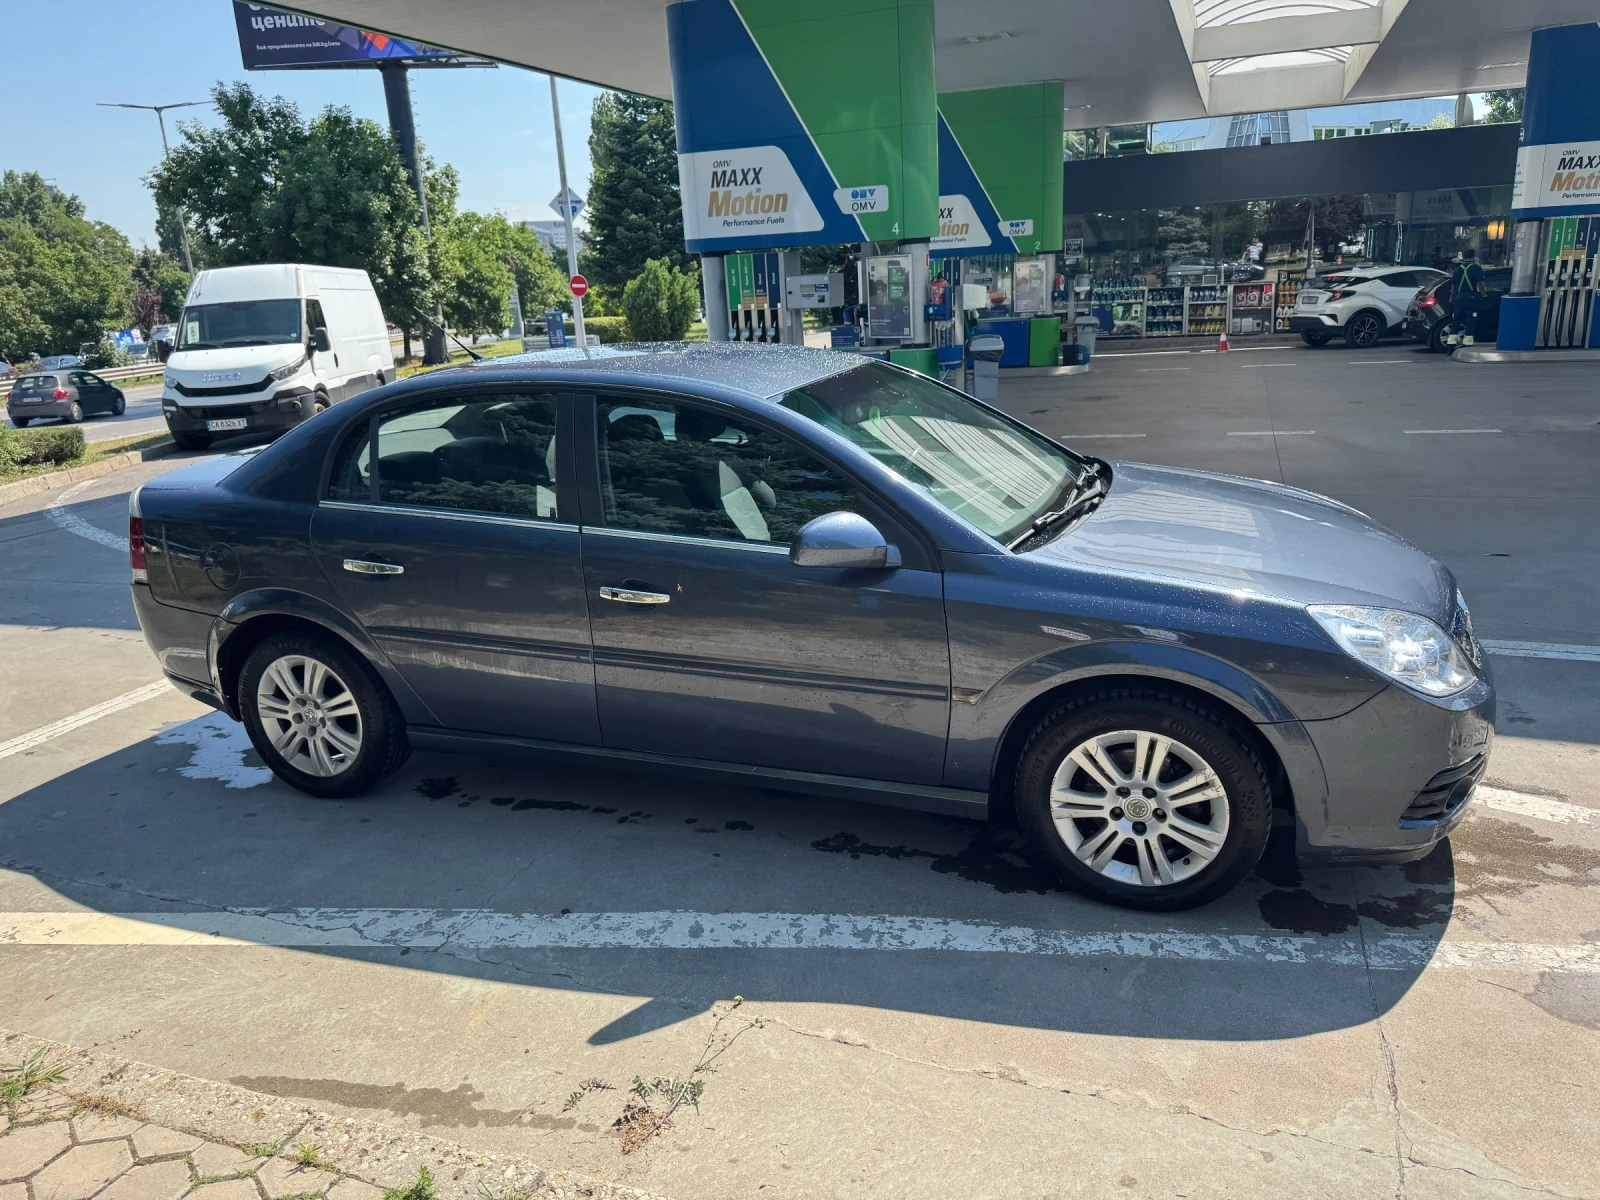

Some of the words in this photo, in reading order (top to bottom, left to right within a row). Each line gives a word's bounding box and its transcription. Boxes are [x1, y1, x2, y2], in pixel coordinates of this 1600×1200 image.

[712, 160, 732, 168] OMV
[710, 166, 763, 189] MAXX
[707, 187, 789, 218] Motion
[851, 201, 876, 211] OMV
[723, 218, 765, 228] Performance
[766, 216, 785, 225] Fuels
[891, 222, 900, 235] 4
[1034, 241, 1041, 250] 2
[203, 372, 241, 382] IVECO
[220, 420, 237, 428] 8326
[1169, 719, 1239, 775] Continental
